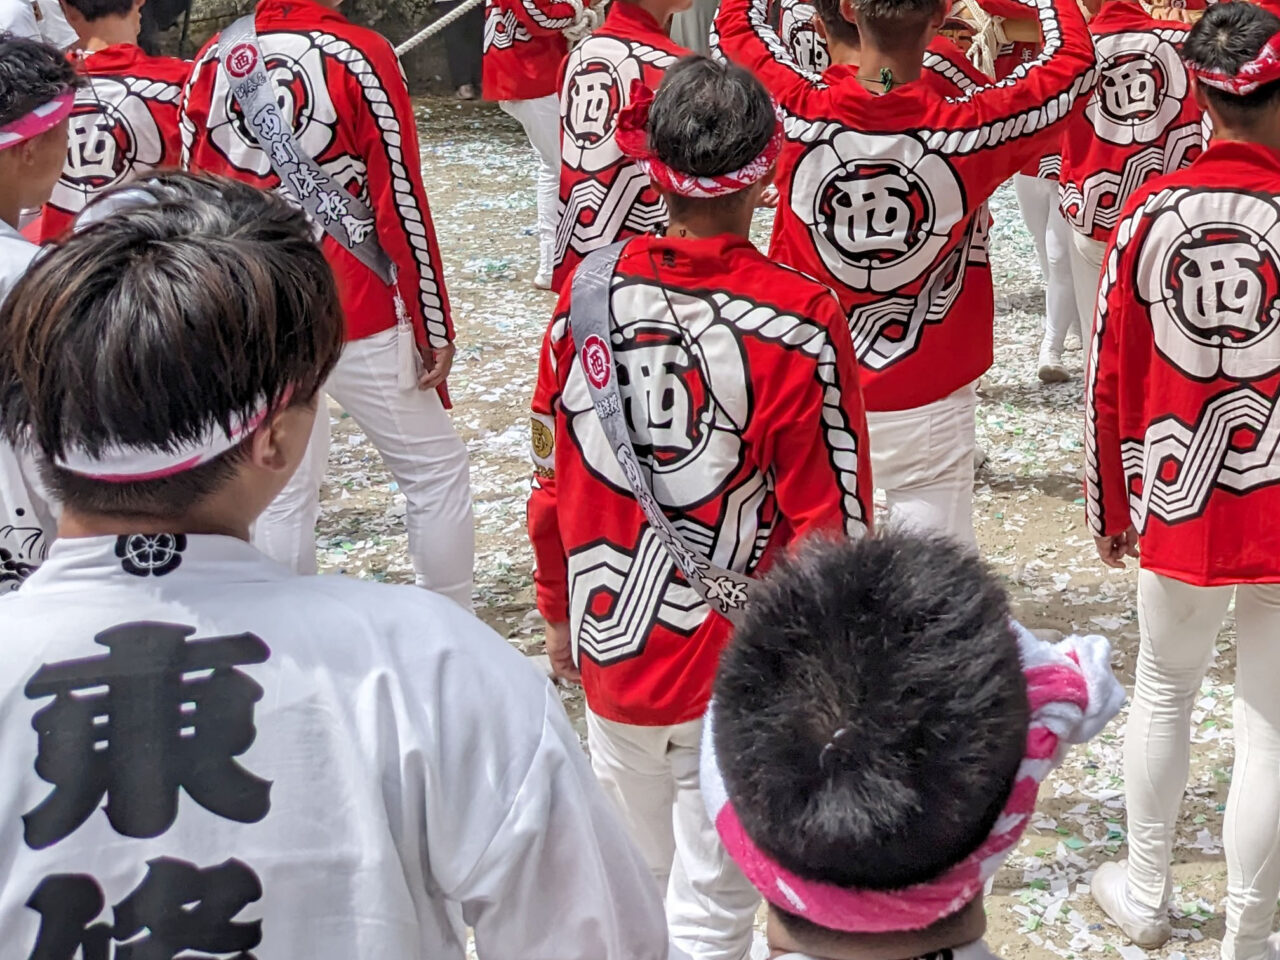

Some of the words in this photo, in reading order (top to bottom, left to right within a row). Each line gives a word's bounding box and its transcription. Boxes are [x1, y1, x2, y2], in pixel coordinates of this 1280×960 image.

[571, 69, 614, 135] 西
[1101, 59, 1157, 118] 西
[829, 172, 913, 254] 西
[1179, 241, 1269, 333] 西
